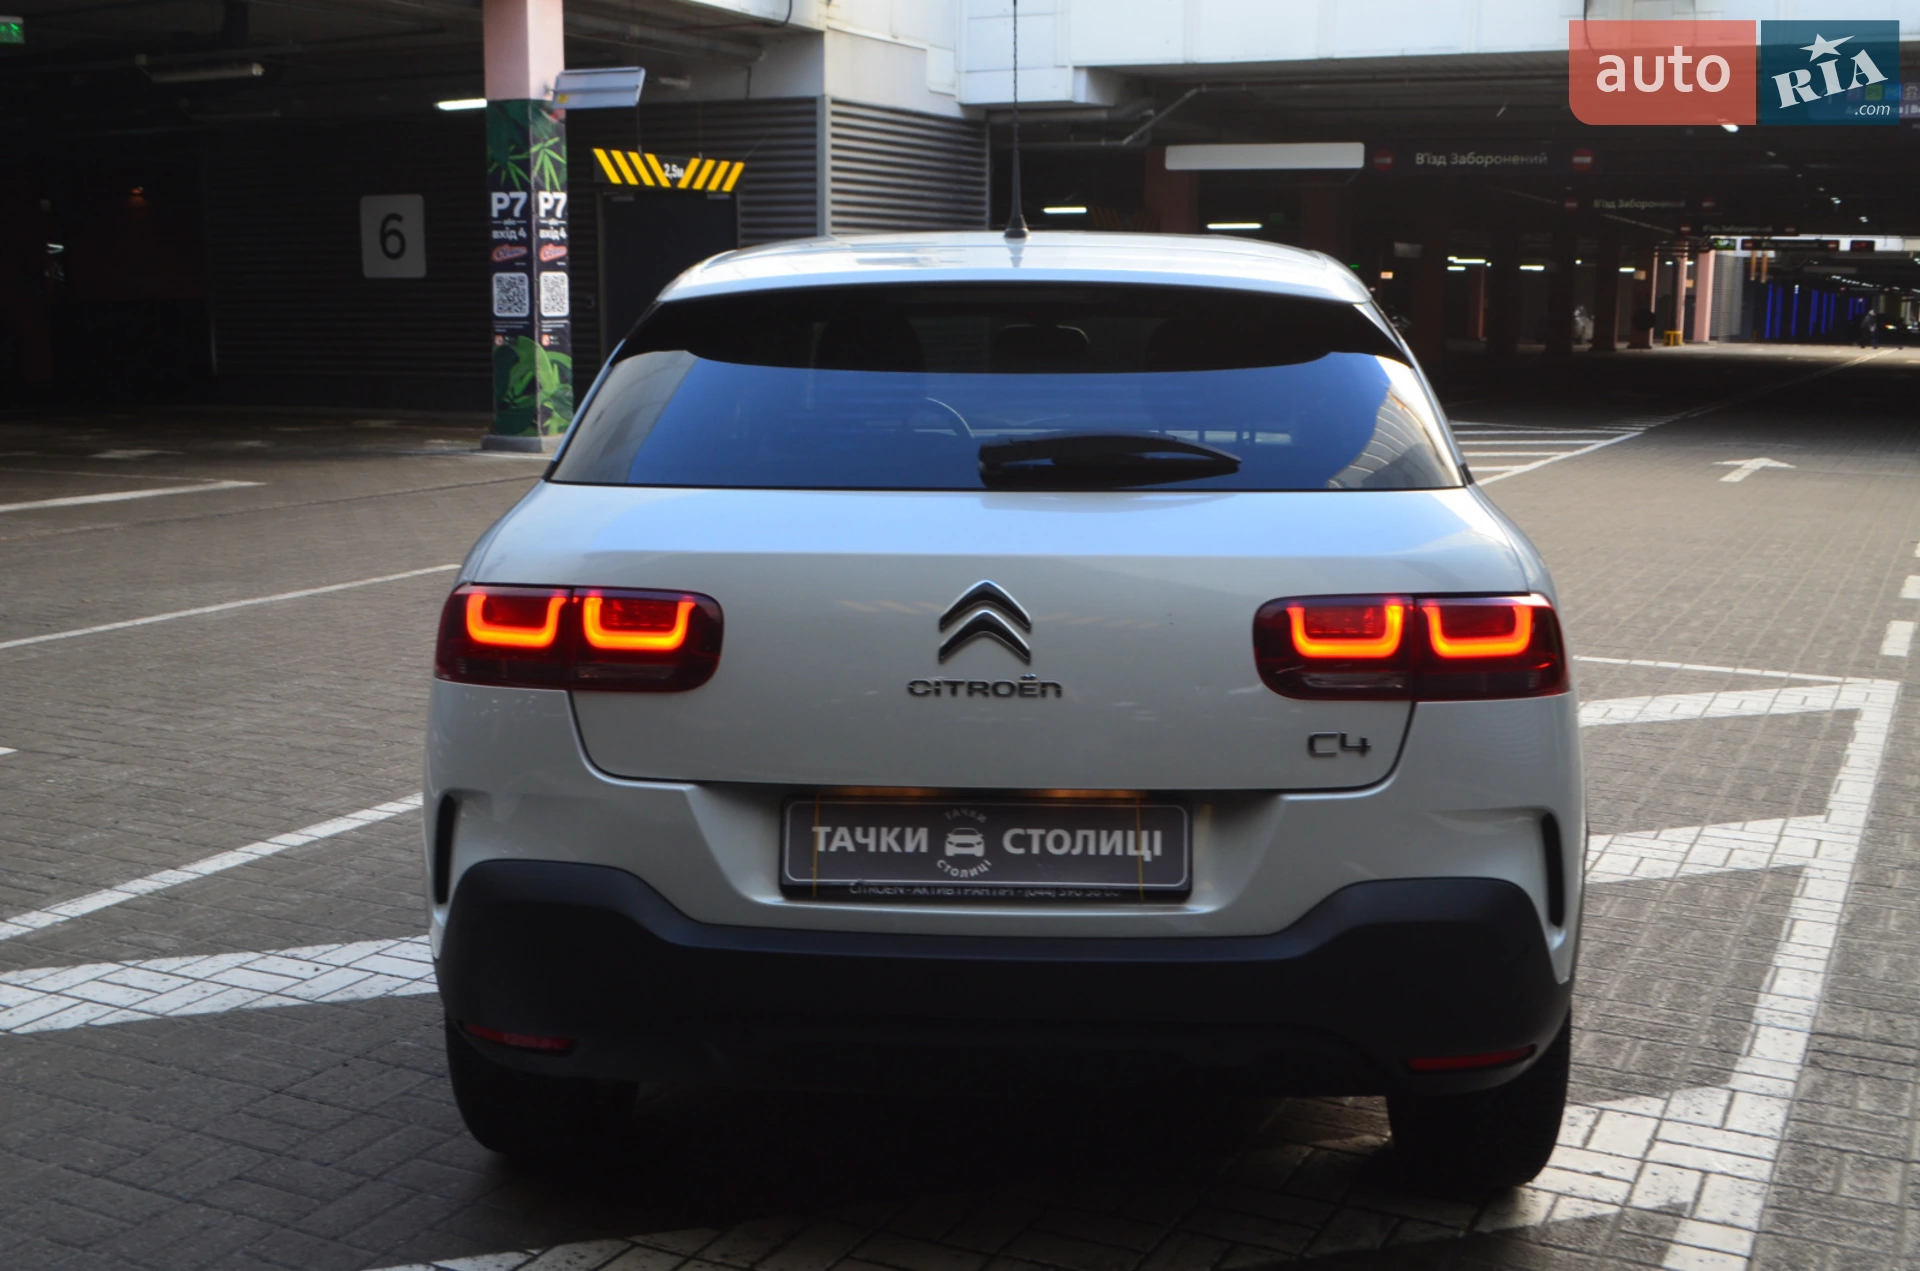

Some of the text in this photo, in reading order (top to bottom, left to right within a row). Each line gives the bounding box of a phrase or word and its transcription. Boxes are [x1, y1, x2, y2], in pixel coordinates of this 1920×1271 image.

[1450, 151, 1548, 168] Заборонений
[491, 191, 528, 218] P7
[538, 190, 568, 218] P7
[379, 212, 407, 260] 6
[1308, 731, 1372, 758] C4
[812, 825, 1162, 862] ТАЧКИ СТОЛИЦІ
[936, 859, 993, 879] СТОЛИЦІ
